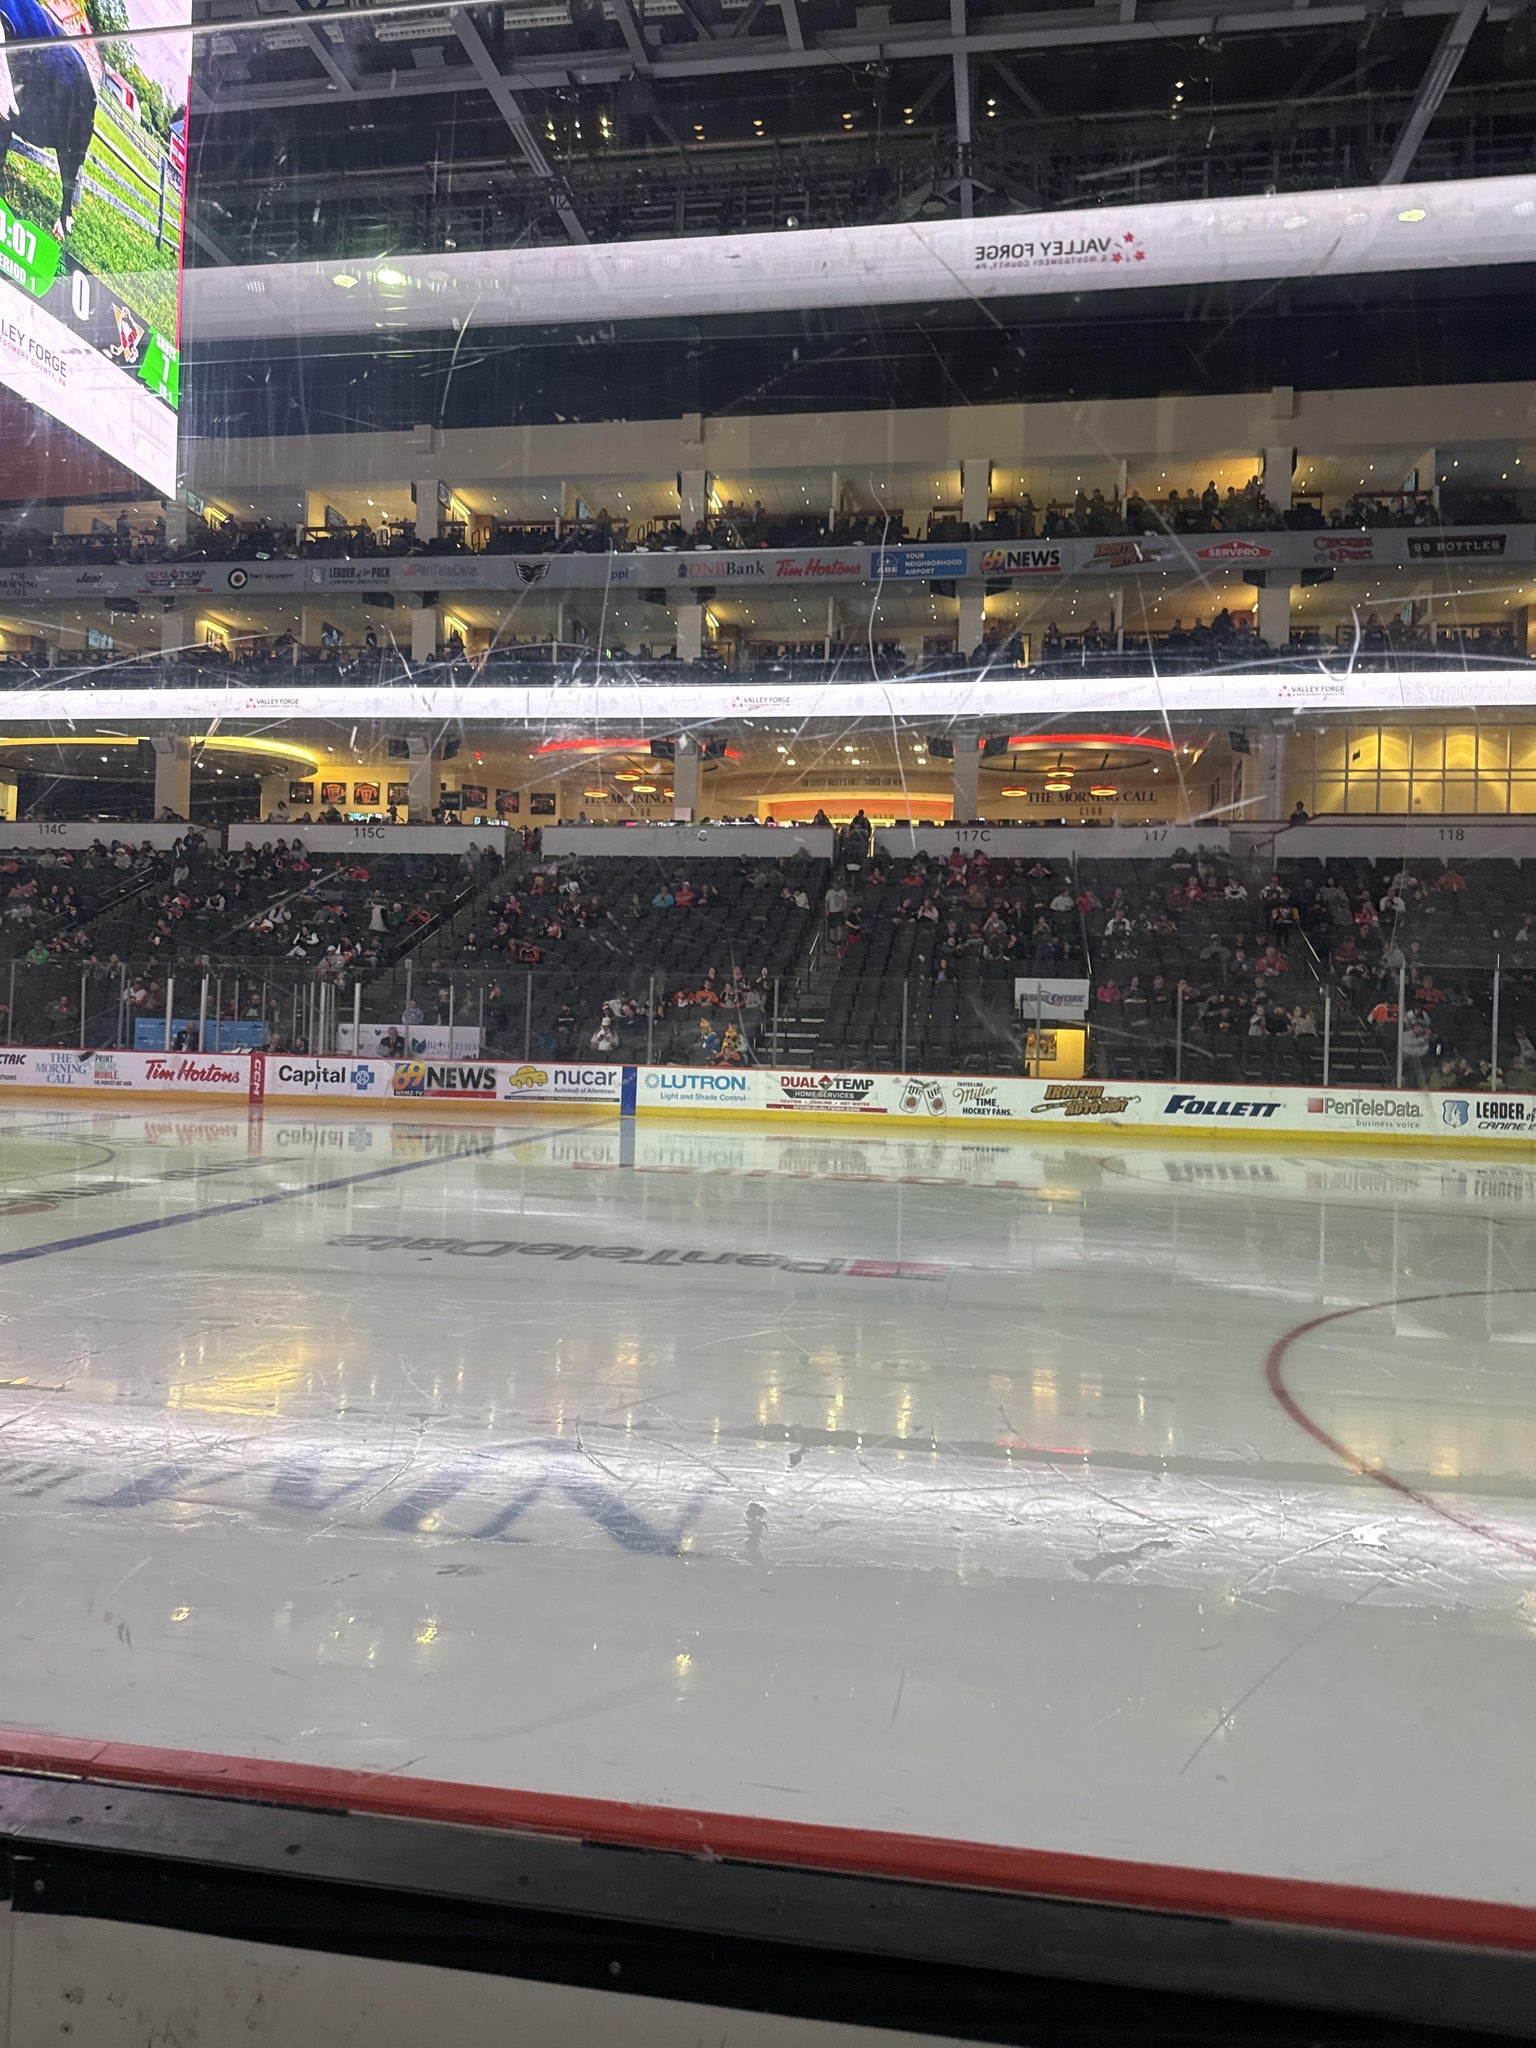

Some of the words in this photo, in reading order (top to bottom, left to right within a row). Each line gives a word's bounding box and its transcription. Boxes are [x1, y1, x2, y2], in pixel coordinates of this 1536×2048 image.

[71, 269, 91, 322] 0
[29, 338, 68, 378] FORGE
[1208, 547, 1260, 558] SERVPRO
[1413, 543, 1431, 553] 99
[1437, 540, 1500, 553] BOTTLES
[904, 552, 925, 560] YOUR
[979, 548, 1007, 570] 69
[1007, 549, 1061, 568] NEWS
[776, 559, 803, 578] Tim
[804, 557, 862, 577] Hortons
[904, 558, 963, 568] NEIGHBORHOOD
[145, 570, 170, 580] DUAL
[179, 569, 207, 580] TEMP
[329, 567, 356, 579] LEADER
[371, 567, 391, 578] PACK
[610, 568, 630, 581] ppl
[904, 567, 935, 576] AIRPORT
[1290, 685, 1320, 693] VALLEY
[1320, 685, 1345, 693] FORGE
[611, 792, 665, 804] MORNING
[1027, 792, 1054, 803] THE
[1057, 791, 1117, 803] MORNING
[1123, 791, 1157, 802] CALL
[38, 823, 67, 835] 114C
[354, 827, 385, 839] 115C
[1144, 829, 1168, 842] 117
[1439, 828, 1465, 841] 118
[955, 830, 992, 842] 117C
[50, 1052, 73, 1063] THE
[35, 1062, 87, 1075] MORNING
[145, 1059, 176, 1081] Tim
[176, 1058, 241, 1084] Hortons
[278, 1061, 346, 1089] Capital
[46, 1073, 75, 1084] CALL
[253, 1058, 262, 1096] CCM
[392, 1061, 426, 1092] 69
[426, 1066, 497, 1090] NEWS
[554, 1069, 617, 1087] nucar
[661, 1074, 747, 1091] LUTRON
[780, 1075, 818, 1089] DUAL
[833, 1078, 875, 1091] TEMP
[660, 1093, 679, 1101] Light
[719, 1094, 746, 1102] Control
[818, 1091, 855, 1100] SERVICES
[953, 1086, 999, 1105] Miller
[1044, 1085, 1104, 1100] IRONTON
[975, 1097, 1000, 1108] TIME,
[1064, 1100, 1099, 1116] AUTO
[1099, 1099, 1129, 1112] BODY
[1163, 1094, 1282, 1118] FOLLETT
[962, 1107, 991, 1116] HOCKEY
[992, 1108, 1013, 1117] FANS.
[1476, 1101, 1525, 1120] LEADER
[1355, 1119, 1394, 1128] business
[1395, 1120, 1421, 1129] voice
[1478, 1122, 1527, 1131] CANINE
